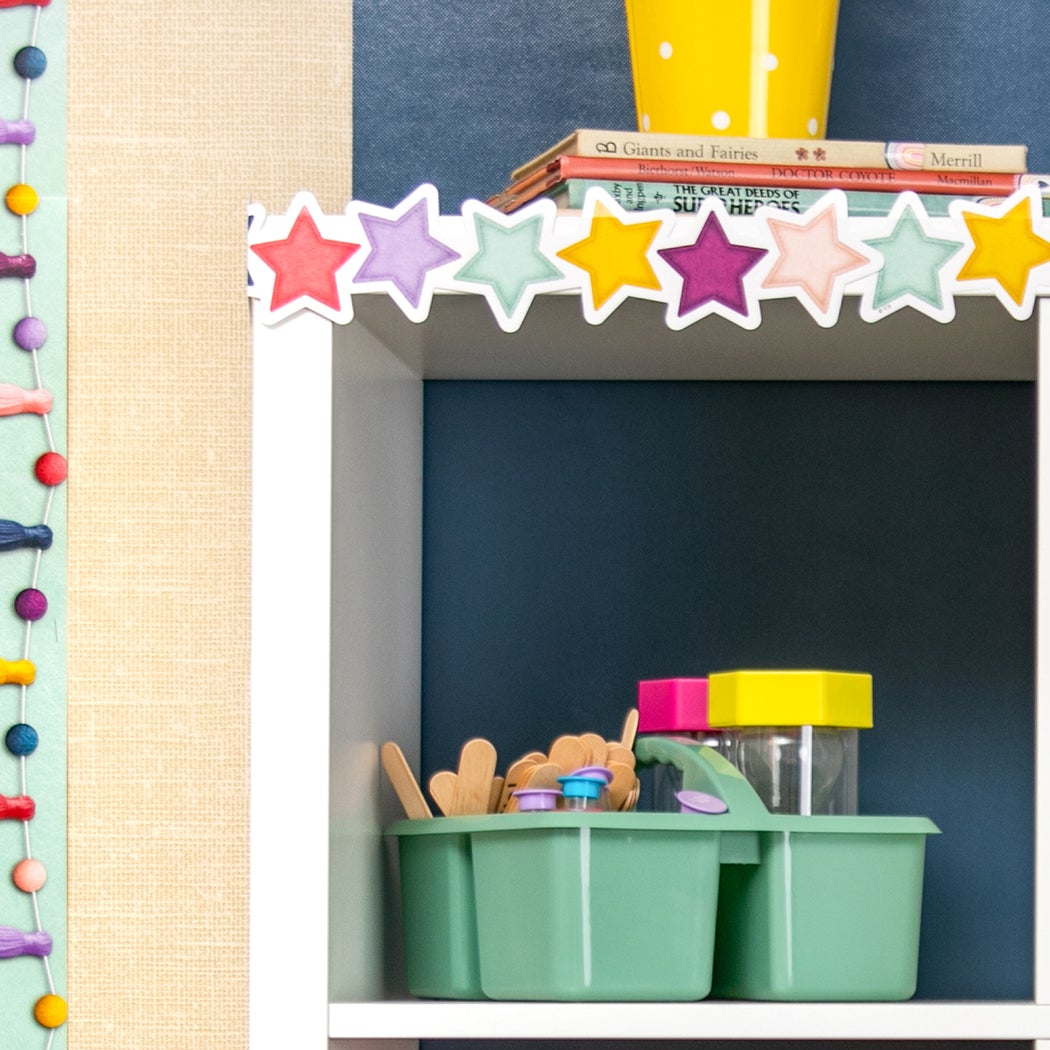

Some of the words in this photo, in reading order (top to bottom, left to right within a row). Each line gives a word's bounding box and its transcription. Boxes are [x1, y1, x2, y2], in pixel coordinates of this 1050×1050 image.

[623, 141, 672, 158] Giants
[676, 144, 705, 159] and
[710, 144, 759, 161] Fairies
[931, 151, 983, 168] Merrill
[771, 167, 833, 180] DOCTOR
[839, 170, 896, 183] COYOTE
[937, 174, 993, 187] Macmillan
[673, 184, 698, 195] THE
[701, 185, 741, 197] GREAT
[745, 187, 781, 199] DEEDS
[783, 189, 800, 200] OF
